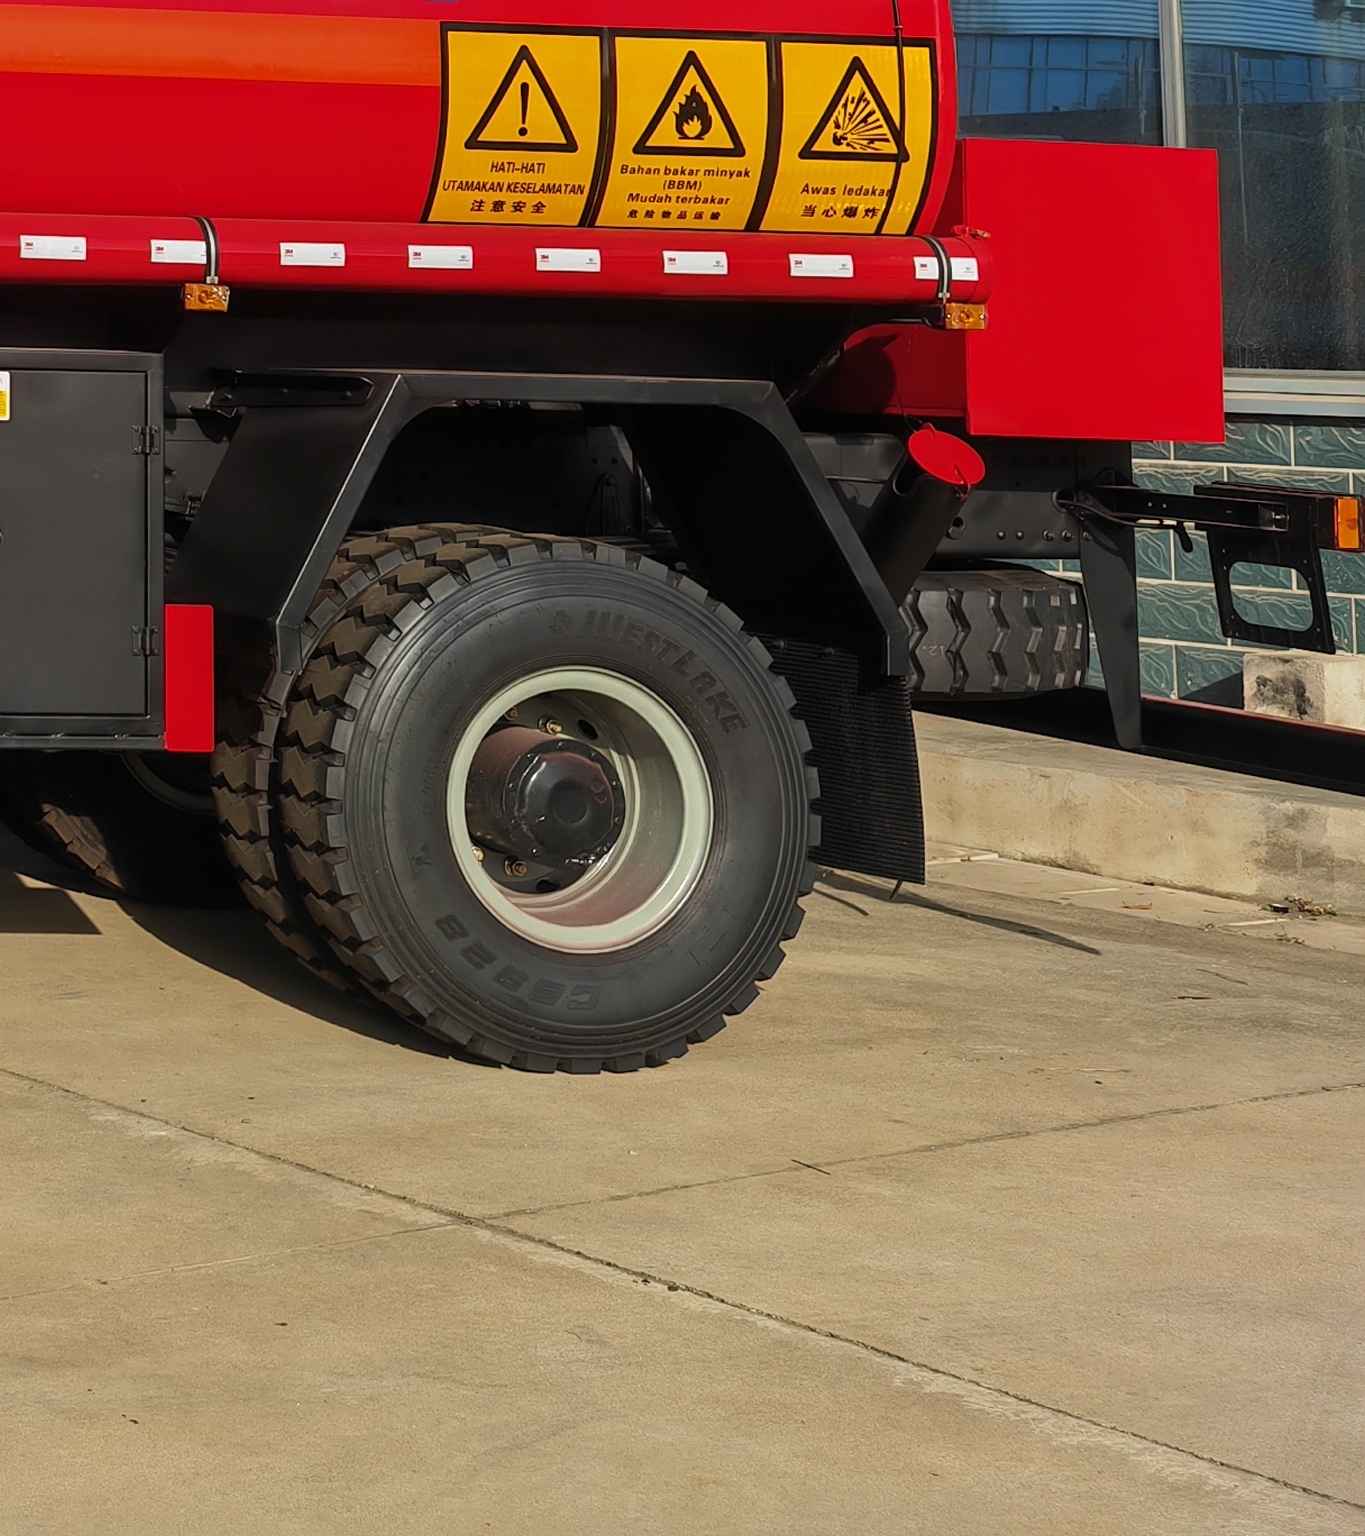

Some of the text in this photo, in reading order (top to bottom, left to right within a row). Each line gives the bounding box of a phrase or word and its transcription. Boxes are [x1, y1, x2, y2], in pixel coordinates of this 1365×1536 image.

[620, 164, 751, 180] Bahan bakar minyak
[442, 180, 585, 195] UTAMAKAN KESELAMATAN
[662, 179, 702, 191] (BBM)
[800, 183, 837, 195] Awas
[469, 199, 547, 214] 注意安全
[627, 193, 730, 205] Mudah terbakar
[801, 204, 880, 219] 当心爆炸
[582, 609, 750, 735] WESTLAKE
